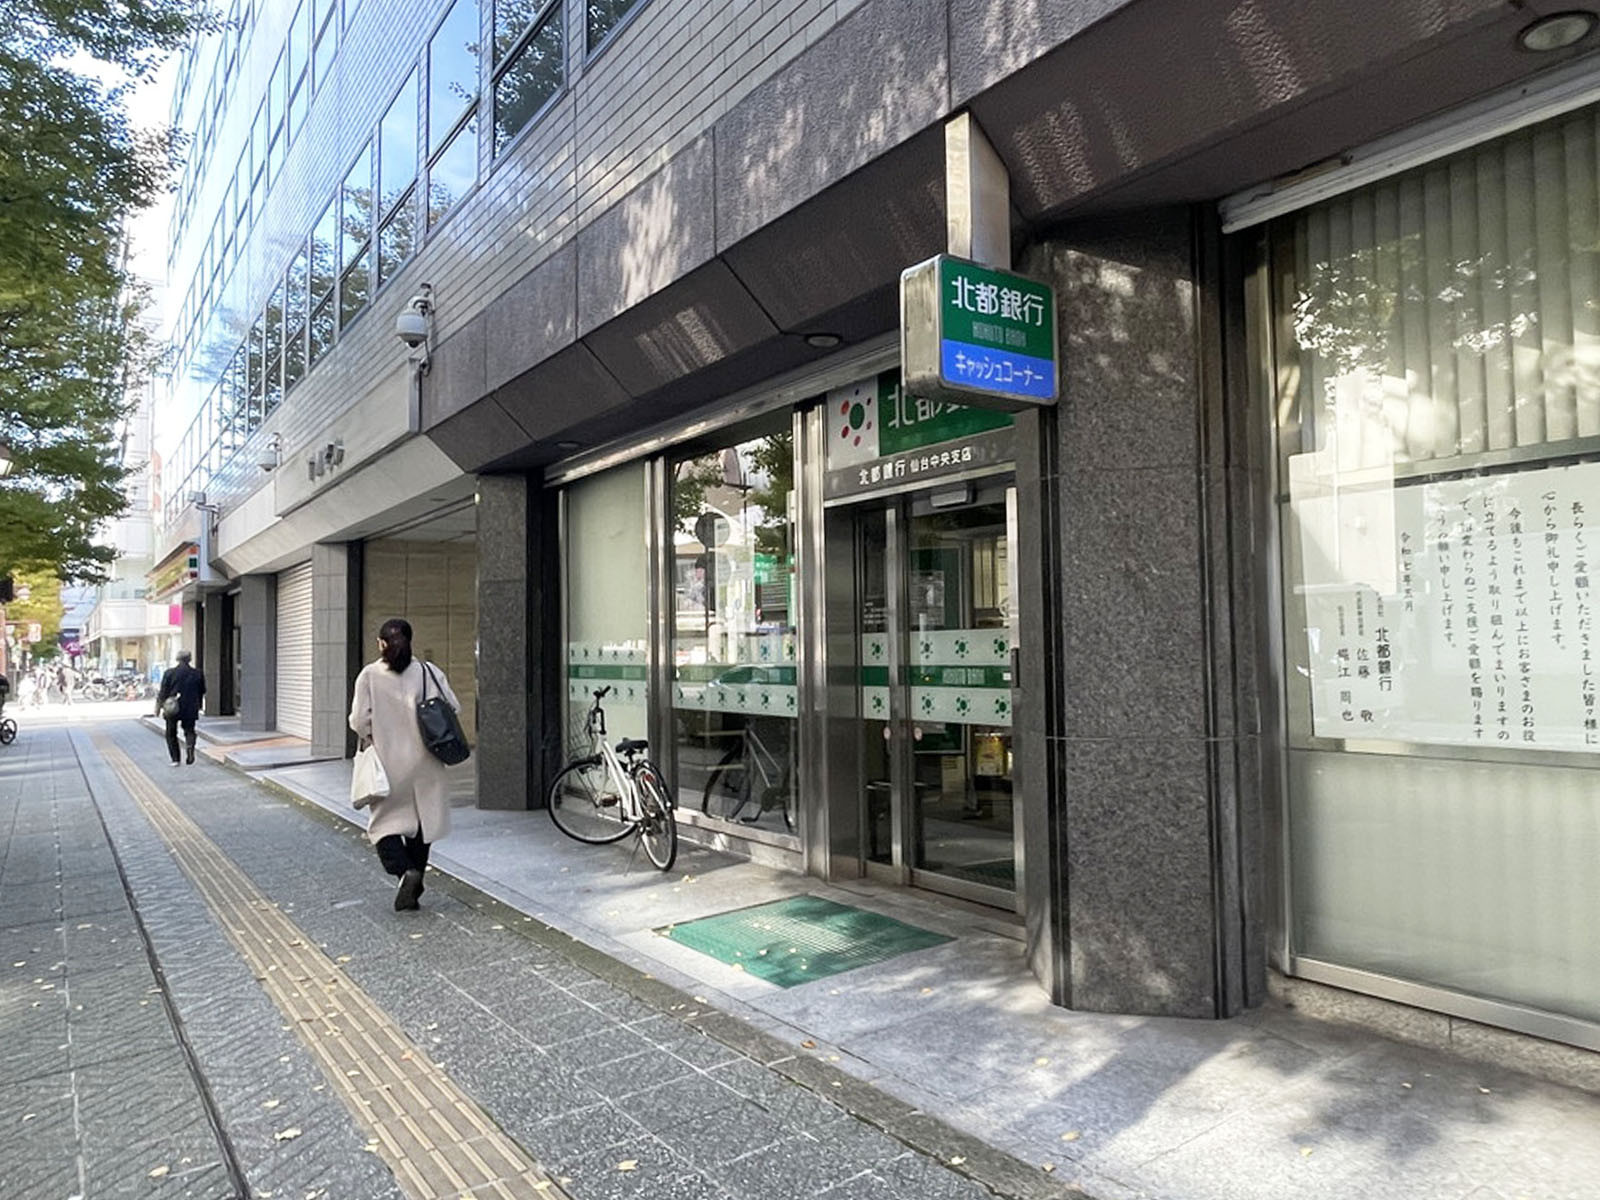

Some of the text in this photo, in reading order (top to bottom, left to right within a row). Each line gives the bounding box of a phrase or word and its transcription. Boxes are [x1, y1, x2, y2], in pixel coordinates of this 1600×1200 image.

[951, 275, 1044, 327] 北都銀行
[955, 350, 1044, 386] キャッシュコーナー
[859, 446, 972, 485] 北都銀行 仙台中央支店
[1375, 626, 1392, 691] 北都銀行
